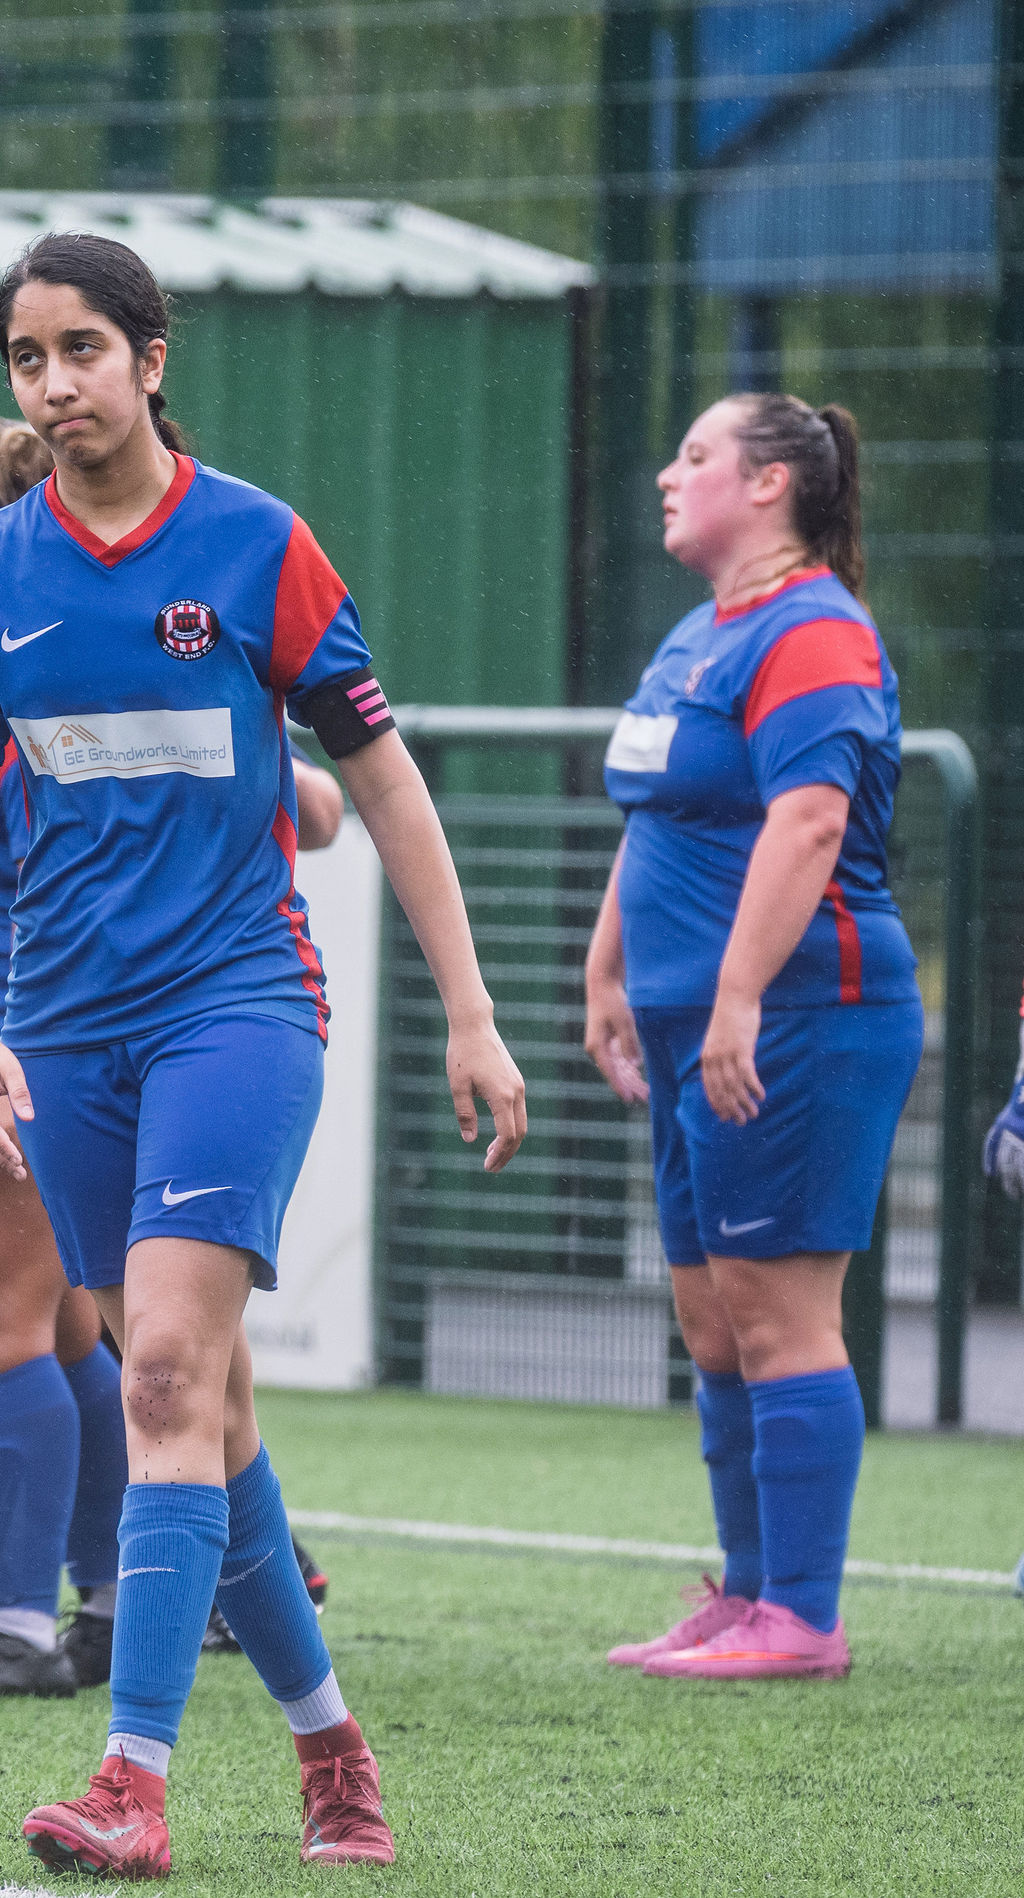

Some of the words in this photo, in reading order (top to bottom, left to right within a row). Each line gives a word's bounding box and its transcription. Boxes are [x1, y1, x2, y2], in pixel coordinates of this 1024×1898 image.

[160, 600, 211, 616] SUNDERLAND
[162, 643, 183, 658] WEST
[185, 651, 202, 660] END
[64, 749, 85, 766] GE
[88, 743, 177, 763] Groundworks
[178, 745, 226, 761] Limited
